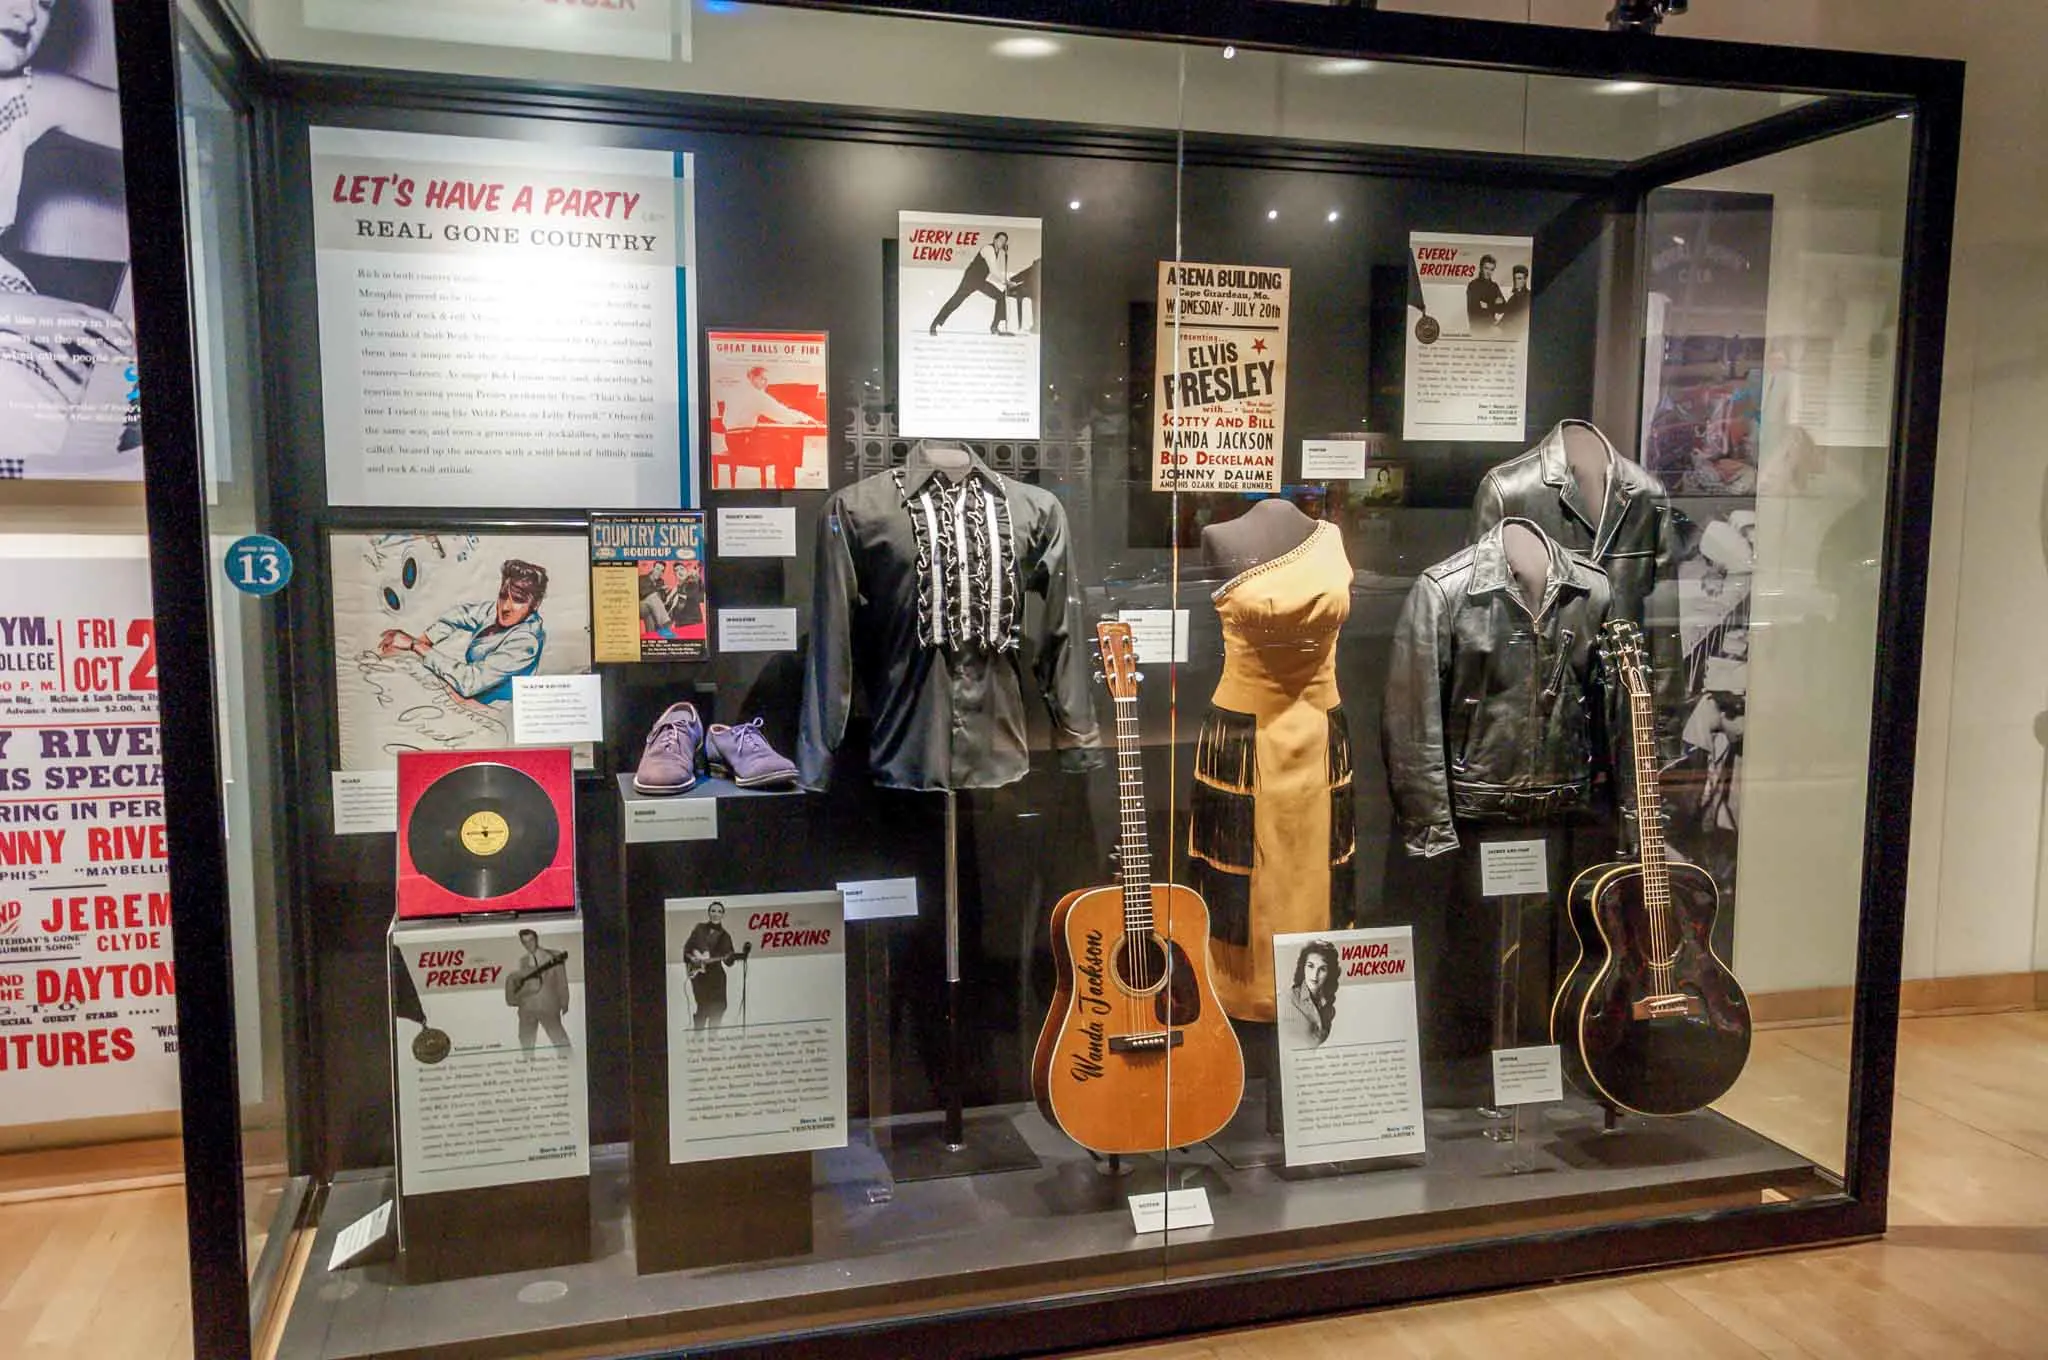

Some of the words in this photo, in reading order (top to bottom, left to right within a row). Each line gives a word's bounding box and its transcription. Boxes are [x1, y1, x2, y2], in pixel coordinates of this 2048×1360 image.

[332, 173, 415, 208] LET'S
[425, 180, 505, 212] HAVE
[512, 186, 533, 215] A
[544, 187, 641, 220] PARTY
[357, 219, 433, 240] REAL
[444, 224, 520, 244] GONE
[530, 230, 657, 252] COUNTRY
[909, 229, 953, 245] JERRY
[956, 231, 980, 246] LEE
[912, 246, 953, 262] LEWIS
[1417, 247, 1458, 260] EVERLY
[1166, 267, 1214, 287] ARENA
[1217, 270, 1282, 290] BUILDING
[1419, 263, 1476, 278] BROTHERS
[1203, 289, 1251, 301] Girardeau,
[1253, 292, 1270, 300] Mo.
[1166, 298, 1224, 317] WDNESDAY
[1232, 302, 1256, 317] JULY
[1259, 304, 1281, 318] 20th
[716, 343, 746, 353] GREAT
[751, 344, 779, 354] BALLS
[784, 345, 796, 354] OF
[801, 345, 820, 356] FIRE
[1188, 342, 1239, 369] ELVIS
[1163, 360, 1276, 410] PRESLEY
[1215, 417, 1244, 428] AND
[1248, 415, 1276, 429] BILL
[1163, 430, 1209, 449] WANDA
[1216, 431, 1273, 450] JACKSON
[1196, 451, 1274, 467] DECKELMAN
[1160, 469, 1215, 480] JOHNNY
[1224, 470, 1273, 481] DAUME
[1160, 481, 1174, 489] AND
[1178, 481, 1188, 489] HIS
[1192, 481, 1215, 489] OZARK
[1218, 481, 1239, 489] RIDGE
[1242, 482, 1273, 490] RUNNERS
[592, 524, 656, 547] COUNTRY
[659, 524, 699, 547] SONG
[623, 547, 672, 557] ROUNDUP
[238, 553, 280, 585] 13
[77, 618, 116, 648] FRI
[126, 618, 158, 691] 2
[74, 656, 123, 692] OCT
[39, 728, 160, 758] RIVE
[71, 802, 98, 819] IN
[109, 801, 162, 818] PER
[88, 824, 168, 861] RIVE
[41, 893, 172, 932] JEREM
[748, 911, 791, 930] CARL
[97, 932, 161, 952] CLYDE
[760, 929, 831, 948] PERKINS
[418, 950, 465, 968] ELVIS
[1341, 943, 1389, 960] WANDA
[426, 966, 503, 988] PRESLEY
[1078, 928, 1112, 1016] Jackson
[1347, 959, 1406, 978] JACKSON
[36, 961, 176, 1004] DAYTON
[42, 1015, 76, 1023] GUEST
[1070, 1020, 1105, 1083] Wanda
